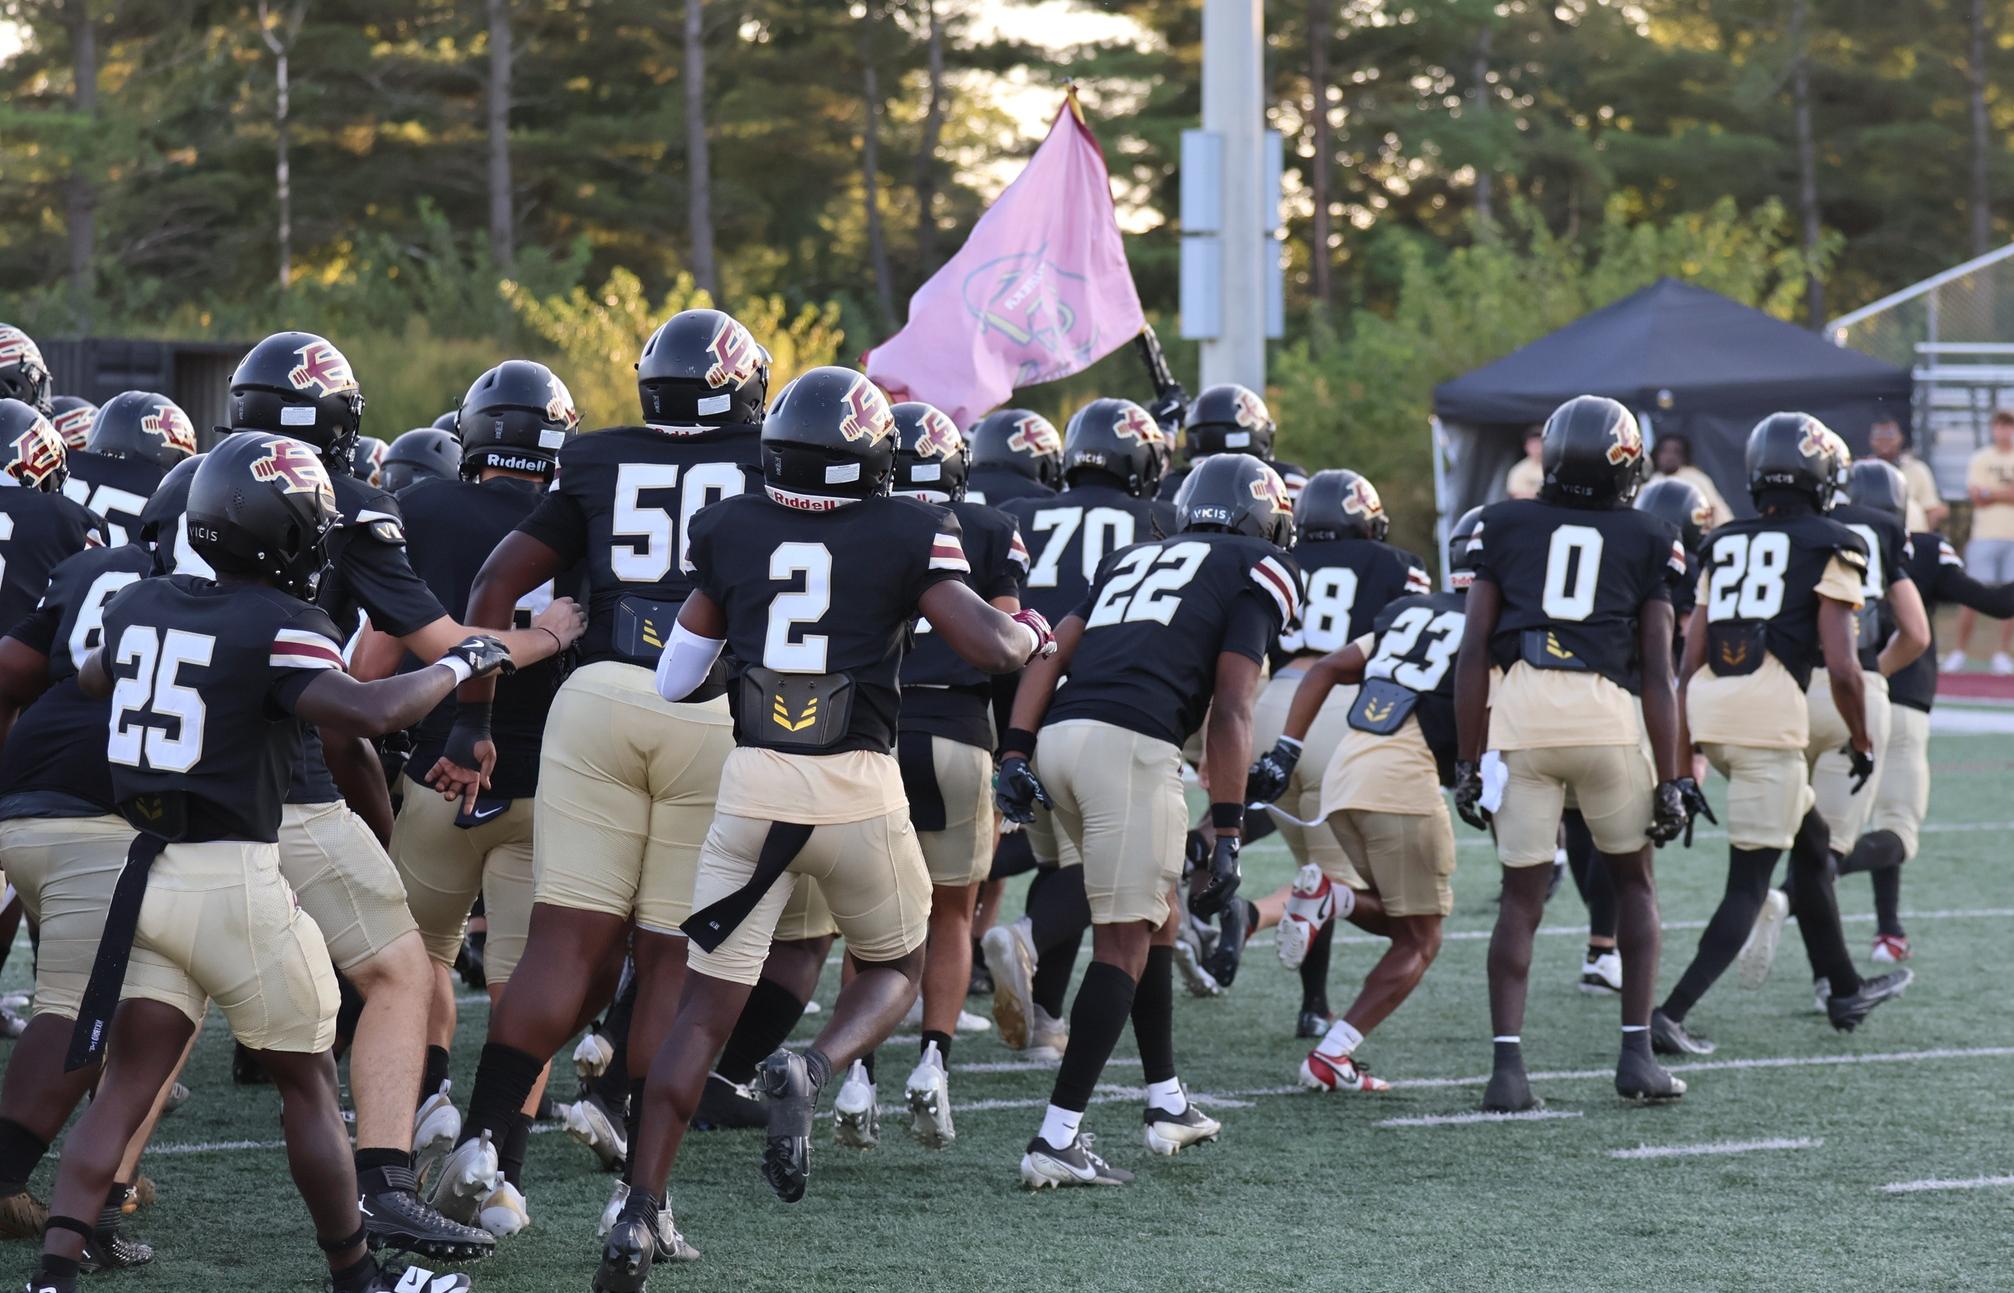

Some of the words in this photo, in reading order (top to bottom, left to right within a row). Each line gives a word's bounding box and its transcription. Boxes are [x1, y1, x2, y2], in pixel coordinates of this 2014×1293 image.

[487, 453, 547, 472] Riddell
[1074, 453, 1106, 465] VICIS
[1765, 473, 1794, 483] VICIS
[1562, 484, 1593, 496] VICIS
[774, 491, 836, 511] Riddell
[1193, 508, 1228, 520] VICIS
[189, 525, 218, 542] VICIS
[1542, 524, 1604, 622] 0
[1707, 531, 1791, 623] 28
[1085, 541, 1212, 629] 22
[763, 541, 833, 674] 2
[1365, 606, 1467, 692] 23
[107, 624, 217, 774] 25
